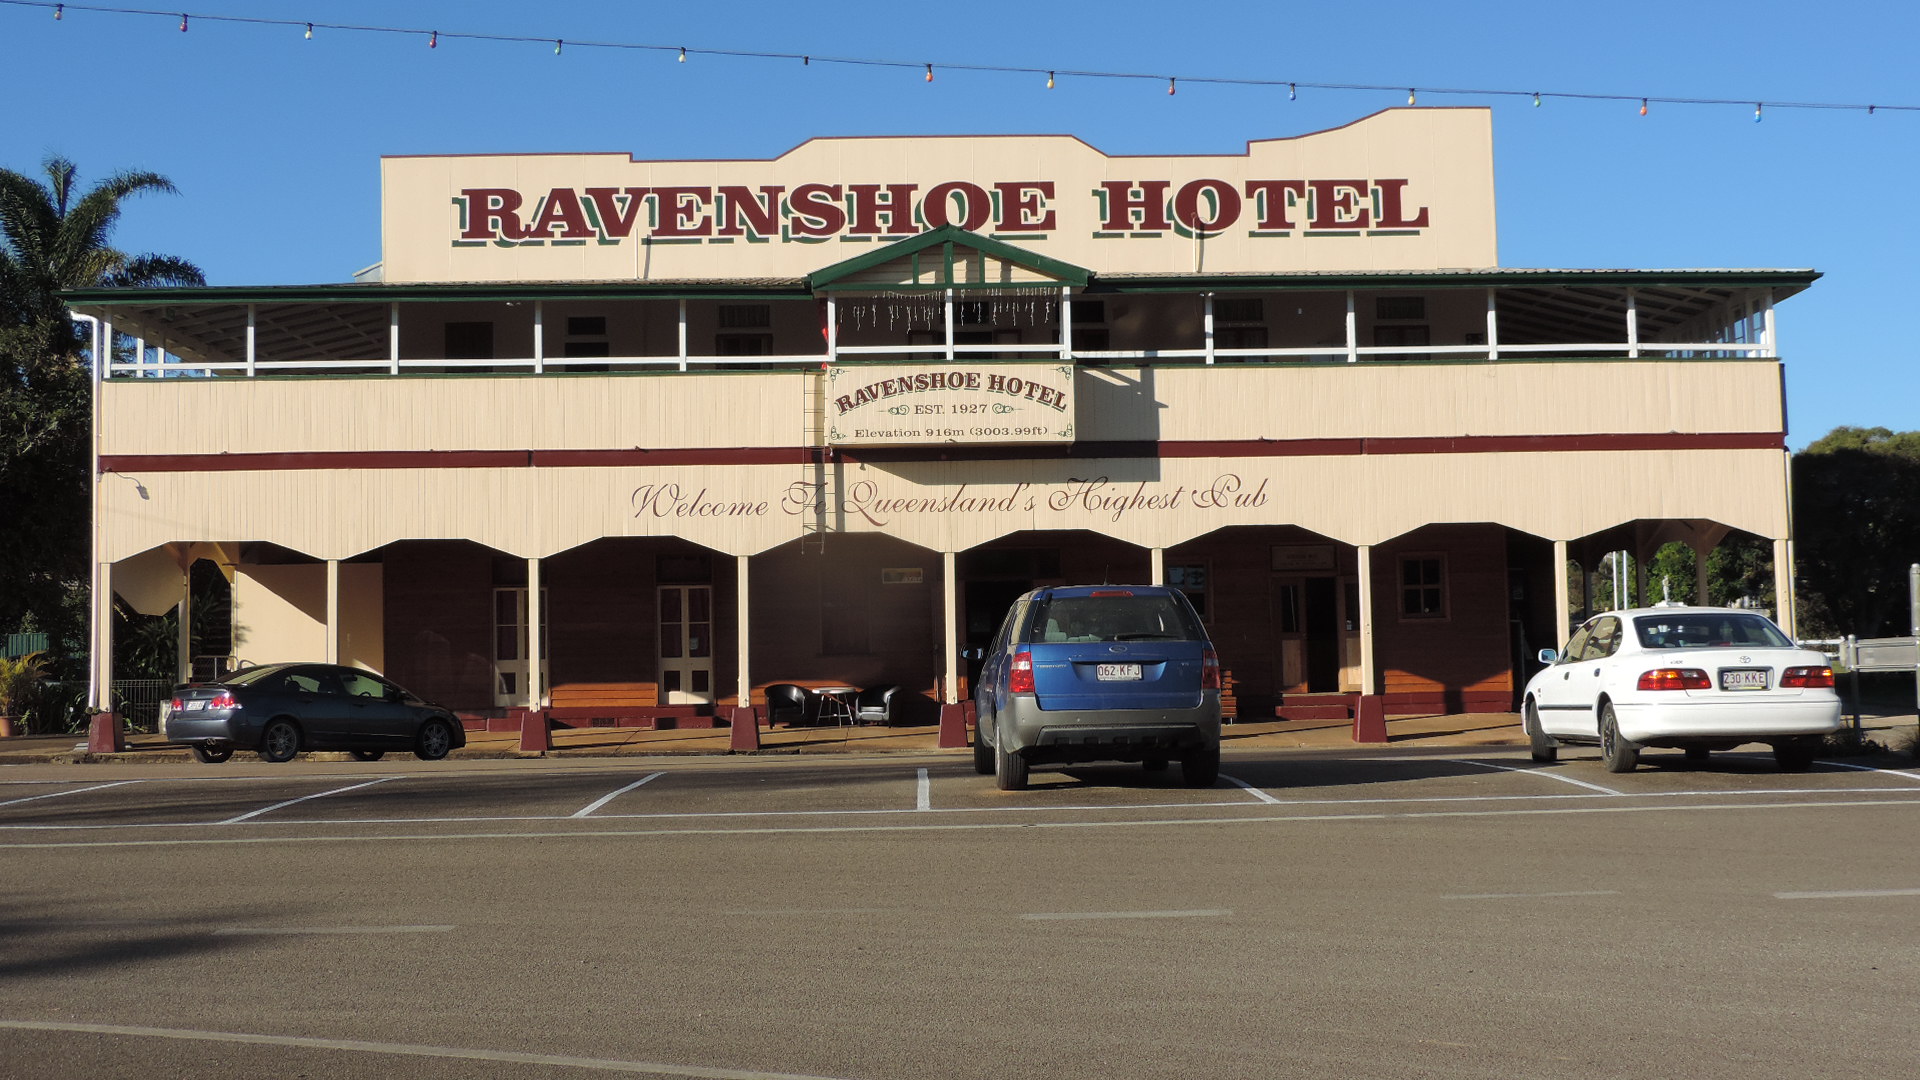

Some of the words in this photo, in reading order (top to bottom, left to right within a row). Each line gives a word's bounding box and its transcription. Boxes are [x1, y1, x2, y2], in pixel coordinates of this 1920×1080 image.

[452, 181, 1056, 247] RAVENSHOE
[1092, 178, 1430, 240] HOTEL
[834, 371, 982, 417] RAVENSHOE
[986, 373, 1068, 414] HOTEL
[913, 404, 945, 415] EST.
[951, 403, 988, 415] 1927
[854, 428, 922, 438] Elevation
[926, 427, 965, 438] 916m
[969, 426, 1049, 437] (3003.99ft)
[631, 483, 770, 519] Welcome
[781, 480, 830, 516] To
[841, 479, 1038, 527] Queensland's
[1047, 475, 1187, 523] Highest
[1190, 472, 1270, 509] Pub
